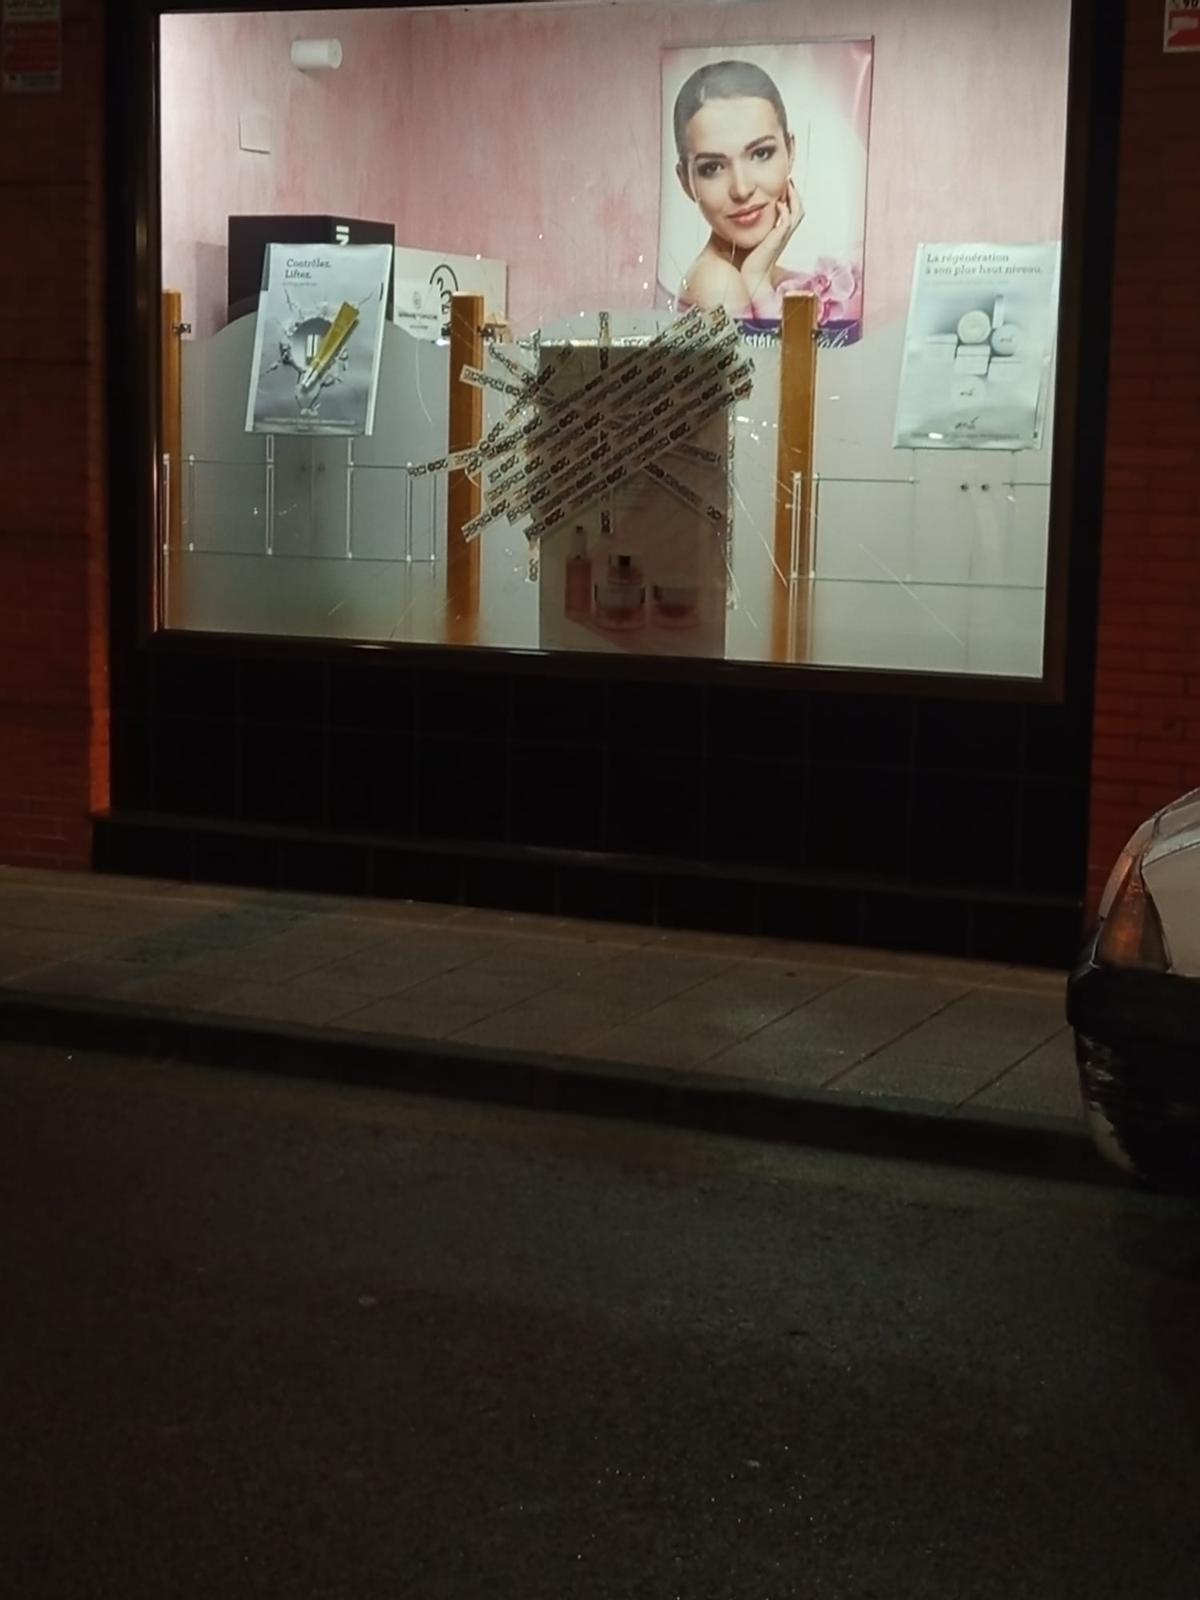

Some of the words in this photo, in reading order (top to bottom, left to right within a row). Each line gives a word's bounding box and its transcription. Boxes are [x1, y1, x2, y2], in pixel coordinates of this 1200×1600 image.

[927, 253, 939, 263] La
[954, 264, 976, 276] plus
[979, 264, 1003, 274] haut
